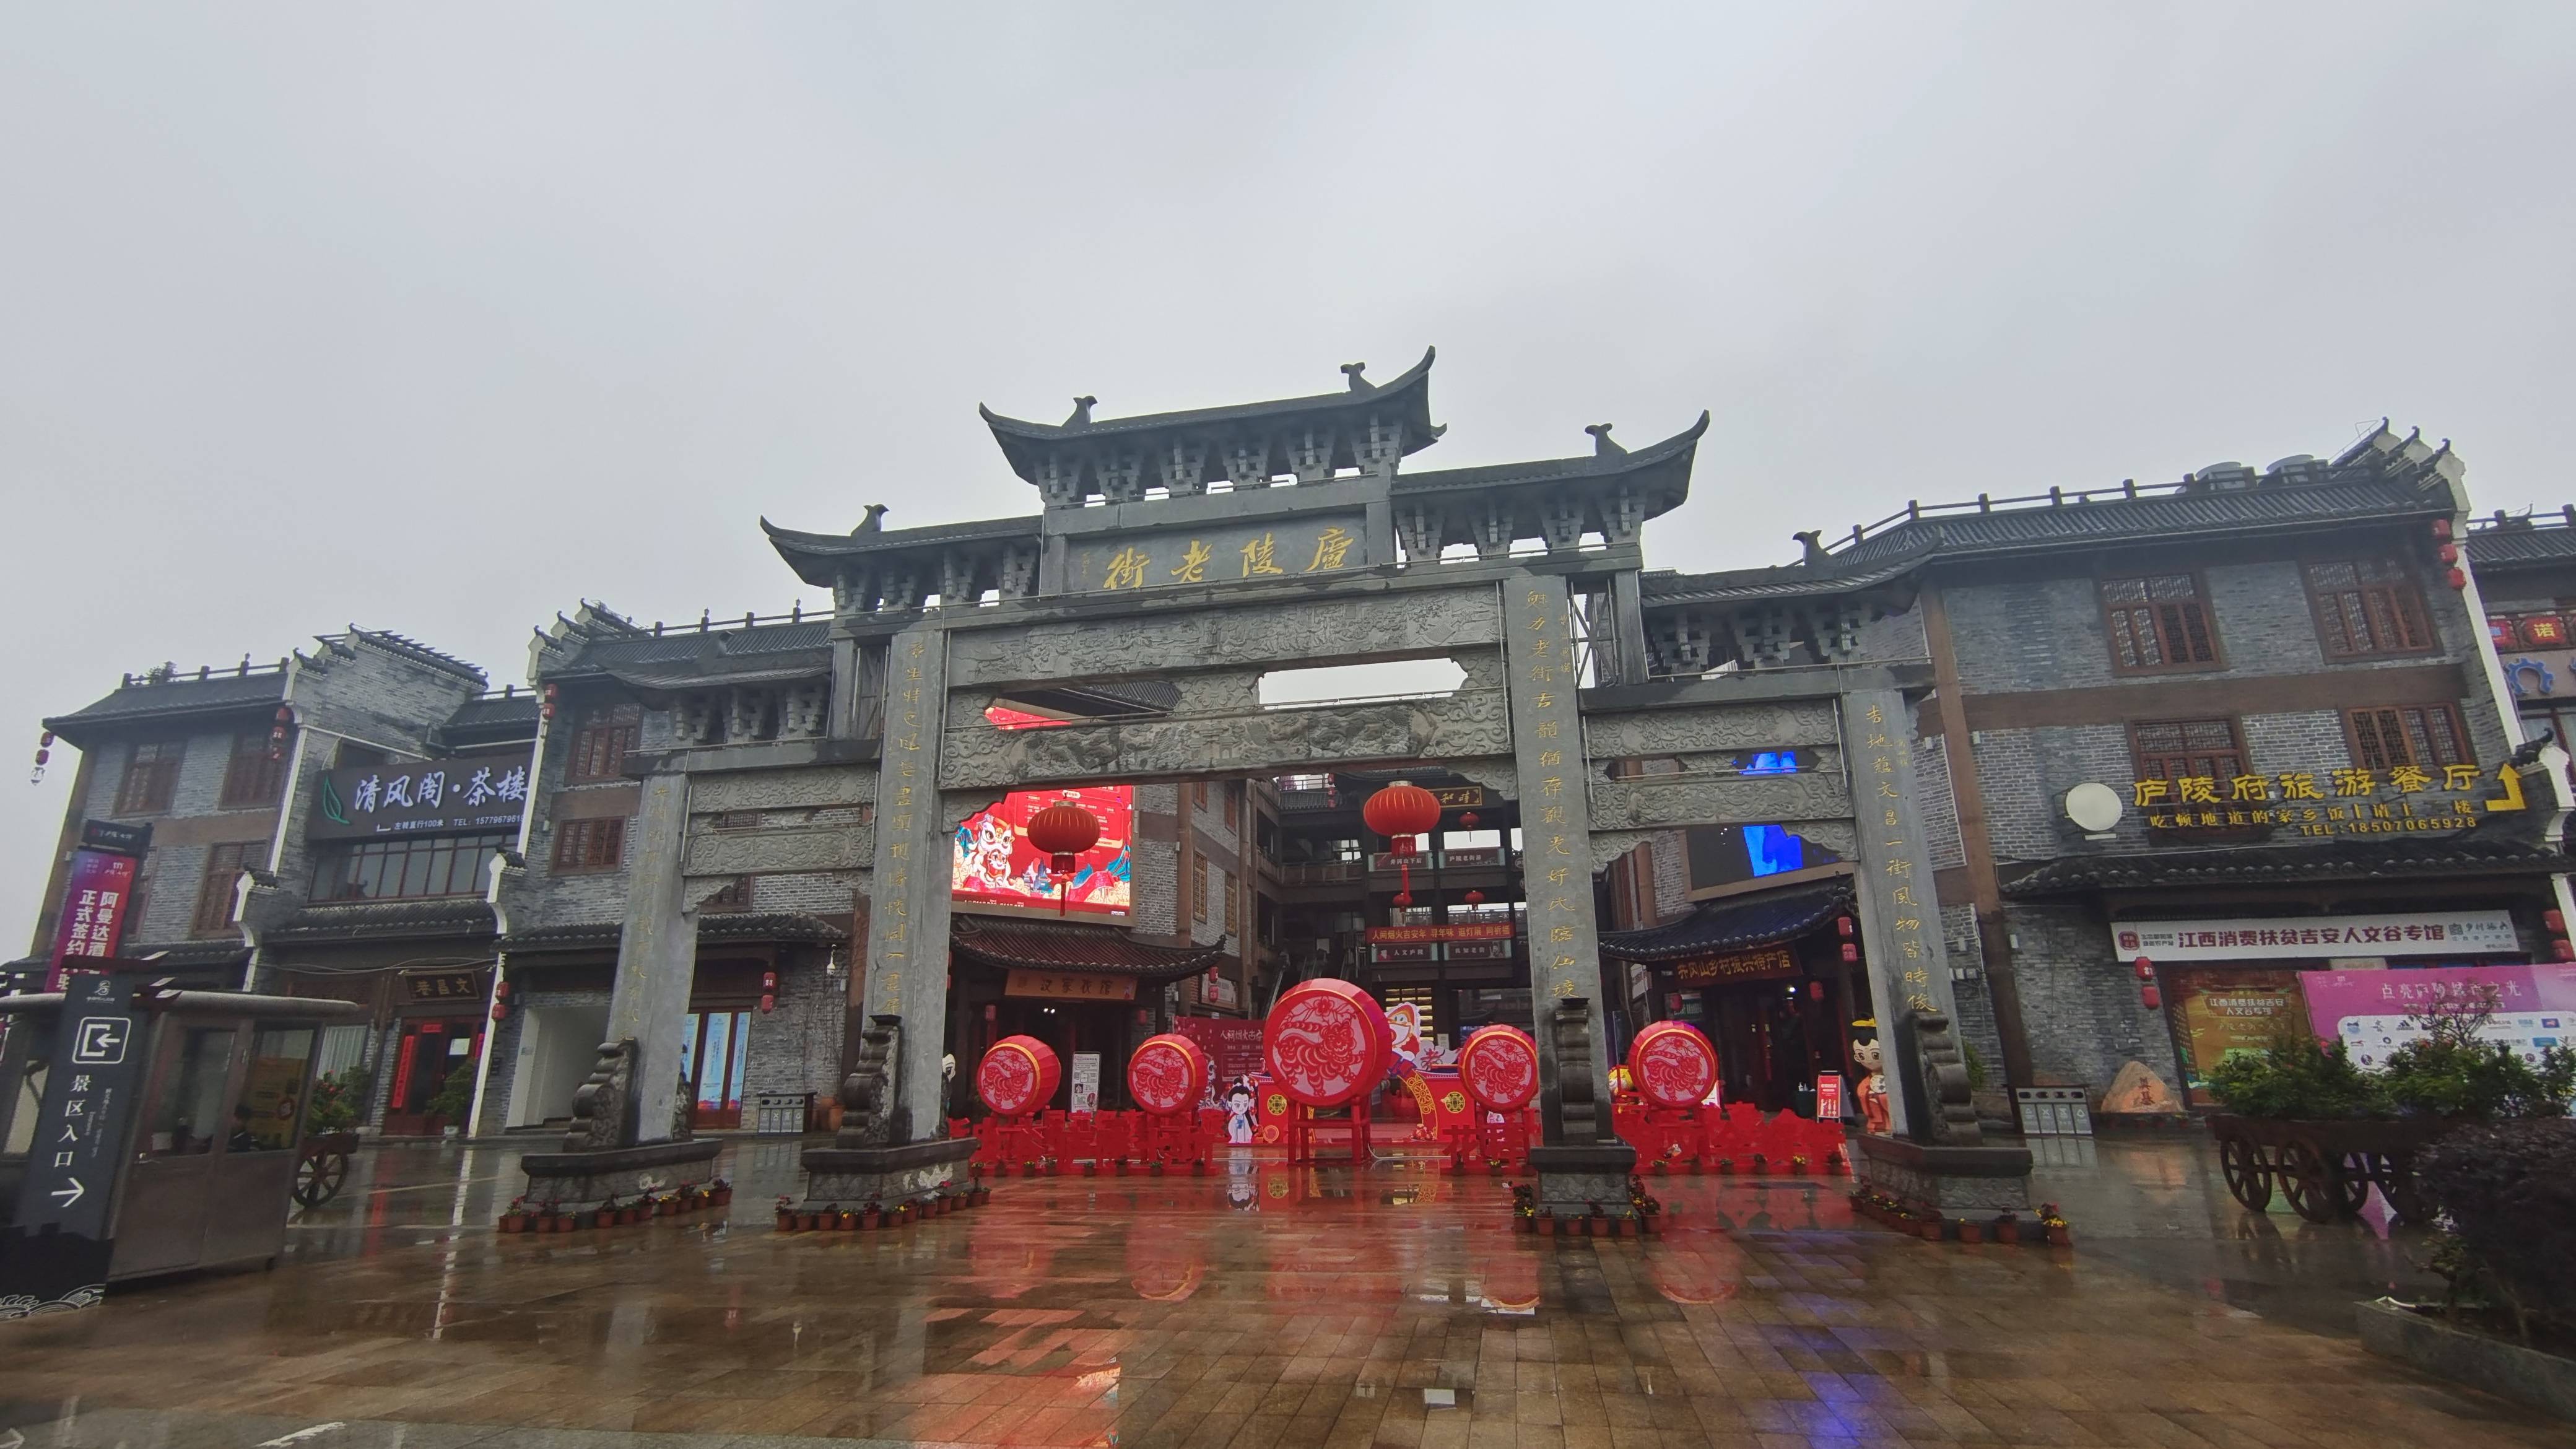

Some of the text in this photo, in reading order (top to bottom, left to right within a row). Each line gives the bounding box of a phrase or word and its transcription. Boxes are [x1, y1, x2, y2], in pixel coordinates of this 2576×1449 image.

[2133, 764, 2481, 807] 庐陵府旅游餐厅
[85, 892, 119, 975] 阿曼达酒
[2178, 925, 2445, 948] 江西消费扶贫吉安人文谷专馆
[53, 1074, 92, 1168] 景区入口
